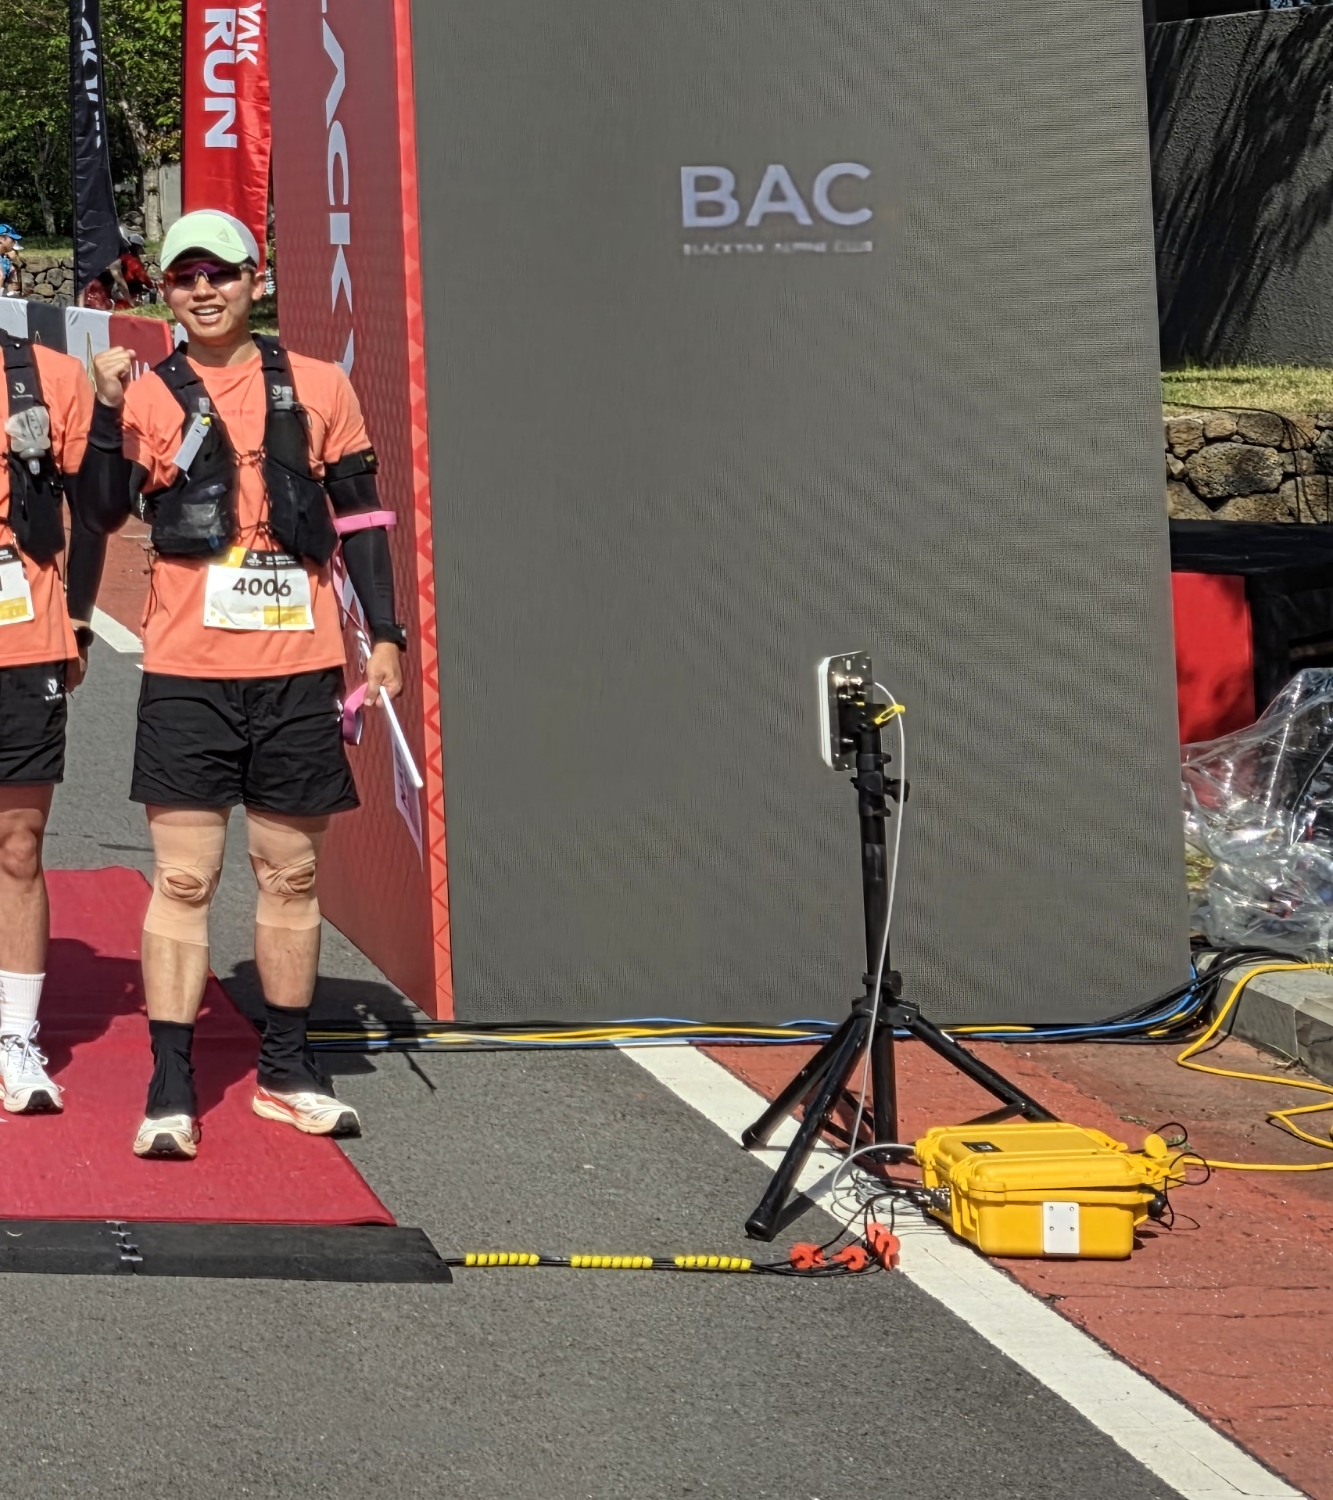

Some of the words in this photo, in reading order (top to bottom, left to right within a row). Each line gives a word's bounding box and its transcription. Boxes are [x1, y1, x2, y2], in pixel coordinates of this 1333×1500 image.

[203, 8, 238, 149] RUN
[680, 162, 873, 227] BAC
[232, 577, 292, 597] 4006
